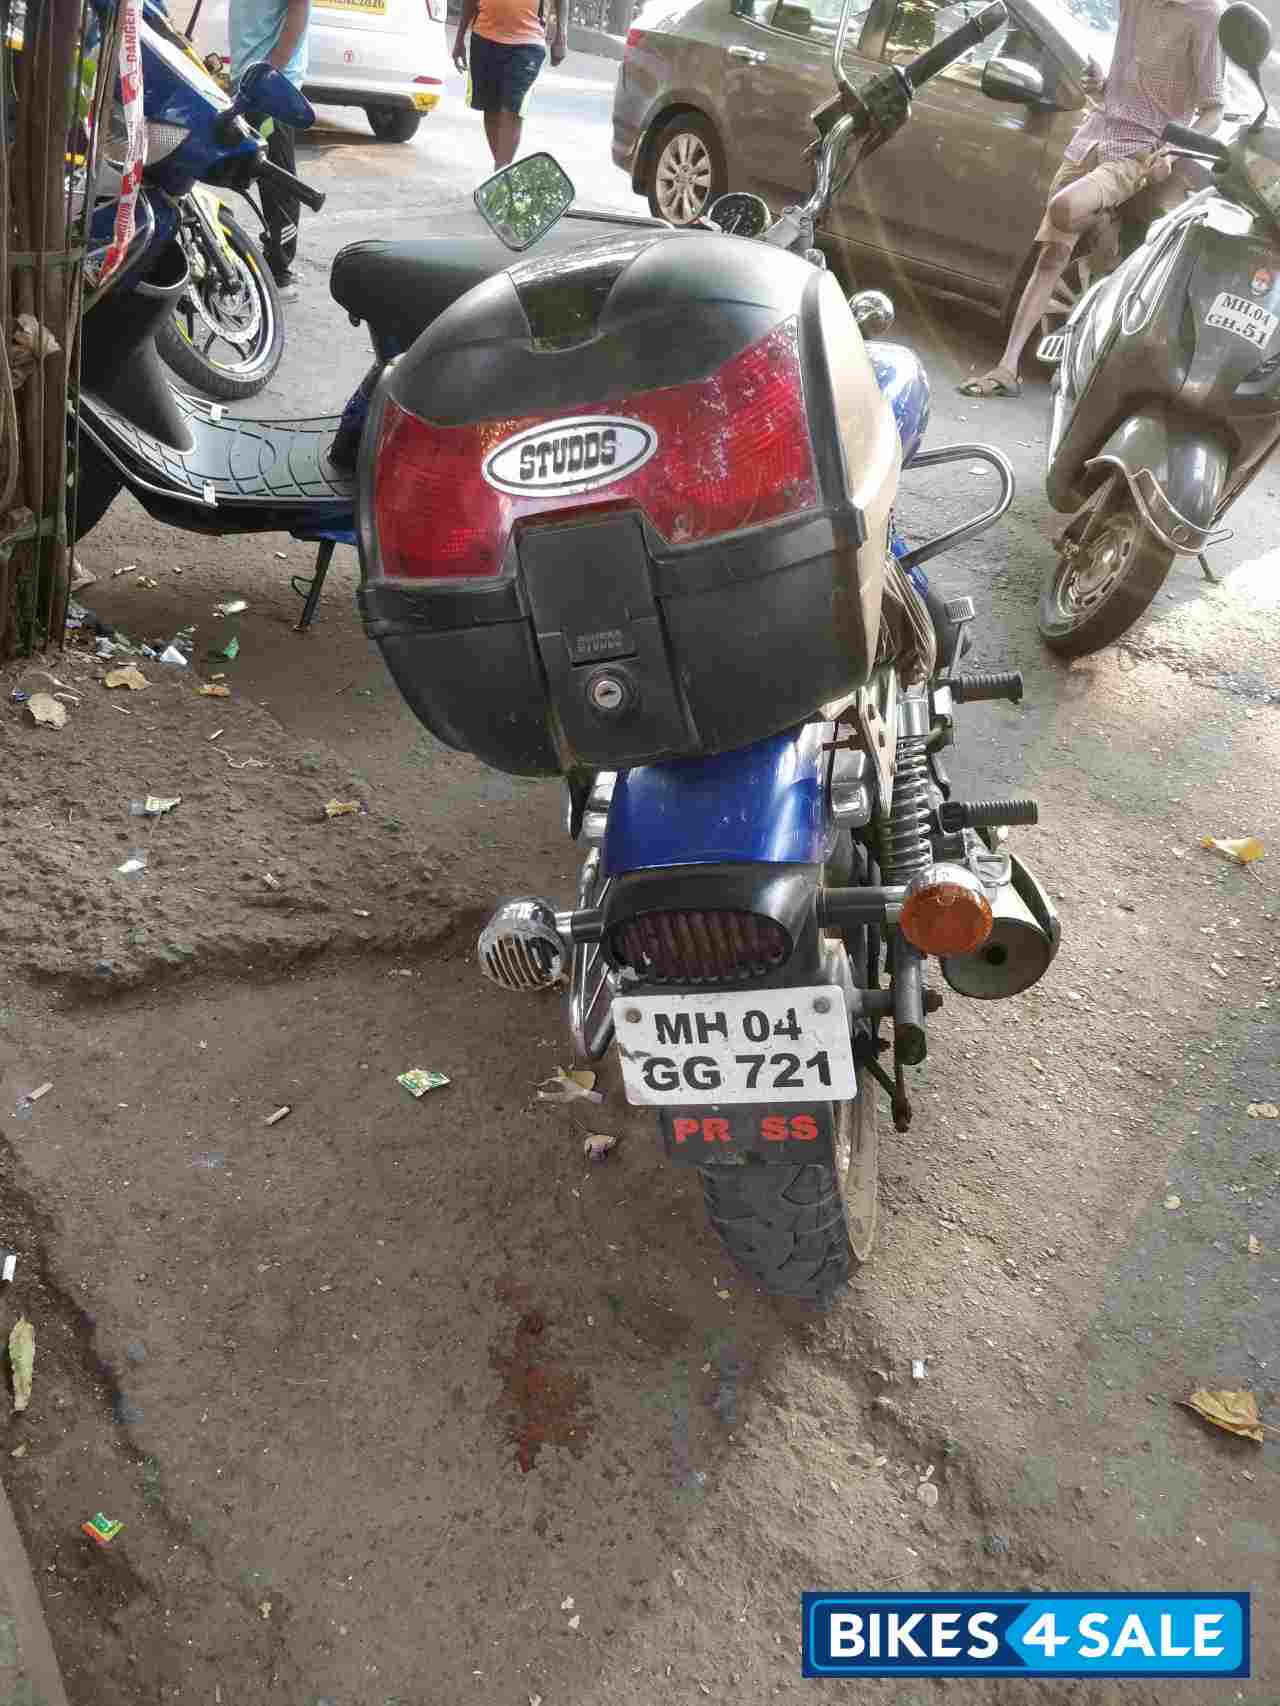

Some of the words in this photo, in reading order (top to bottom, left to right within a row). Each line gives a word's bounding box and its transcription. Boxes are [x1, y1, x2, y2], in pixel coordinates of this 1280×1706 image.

[519, 428, 617, 481] STUDDS
[654, 1011, 728, 1045] MH
[741, 1008, 802, 1043] 04
[641, 1055, 722, 1092] GG
[735, 1050, 832, 1089] 721
